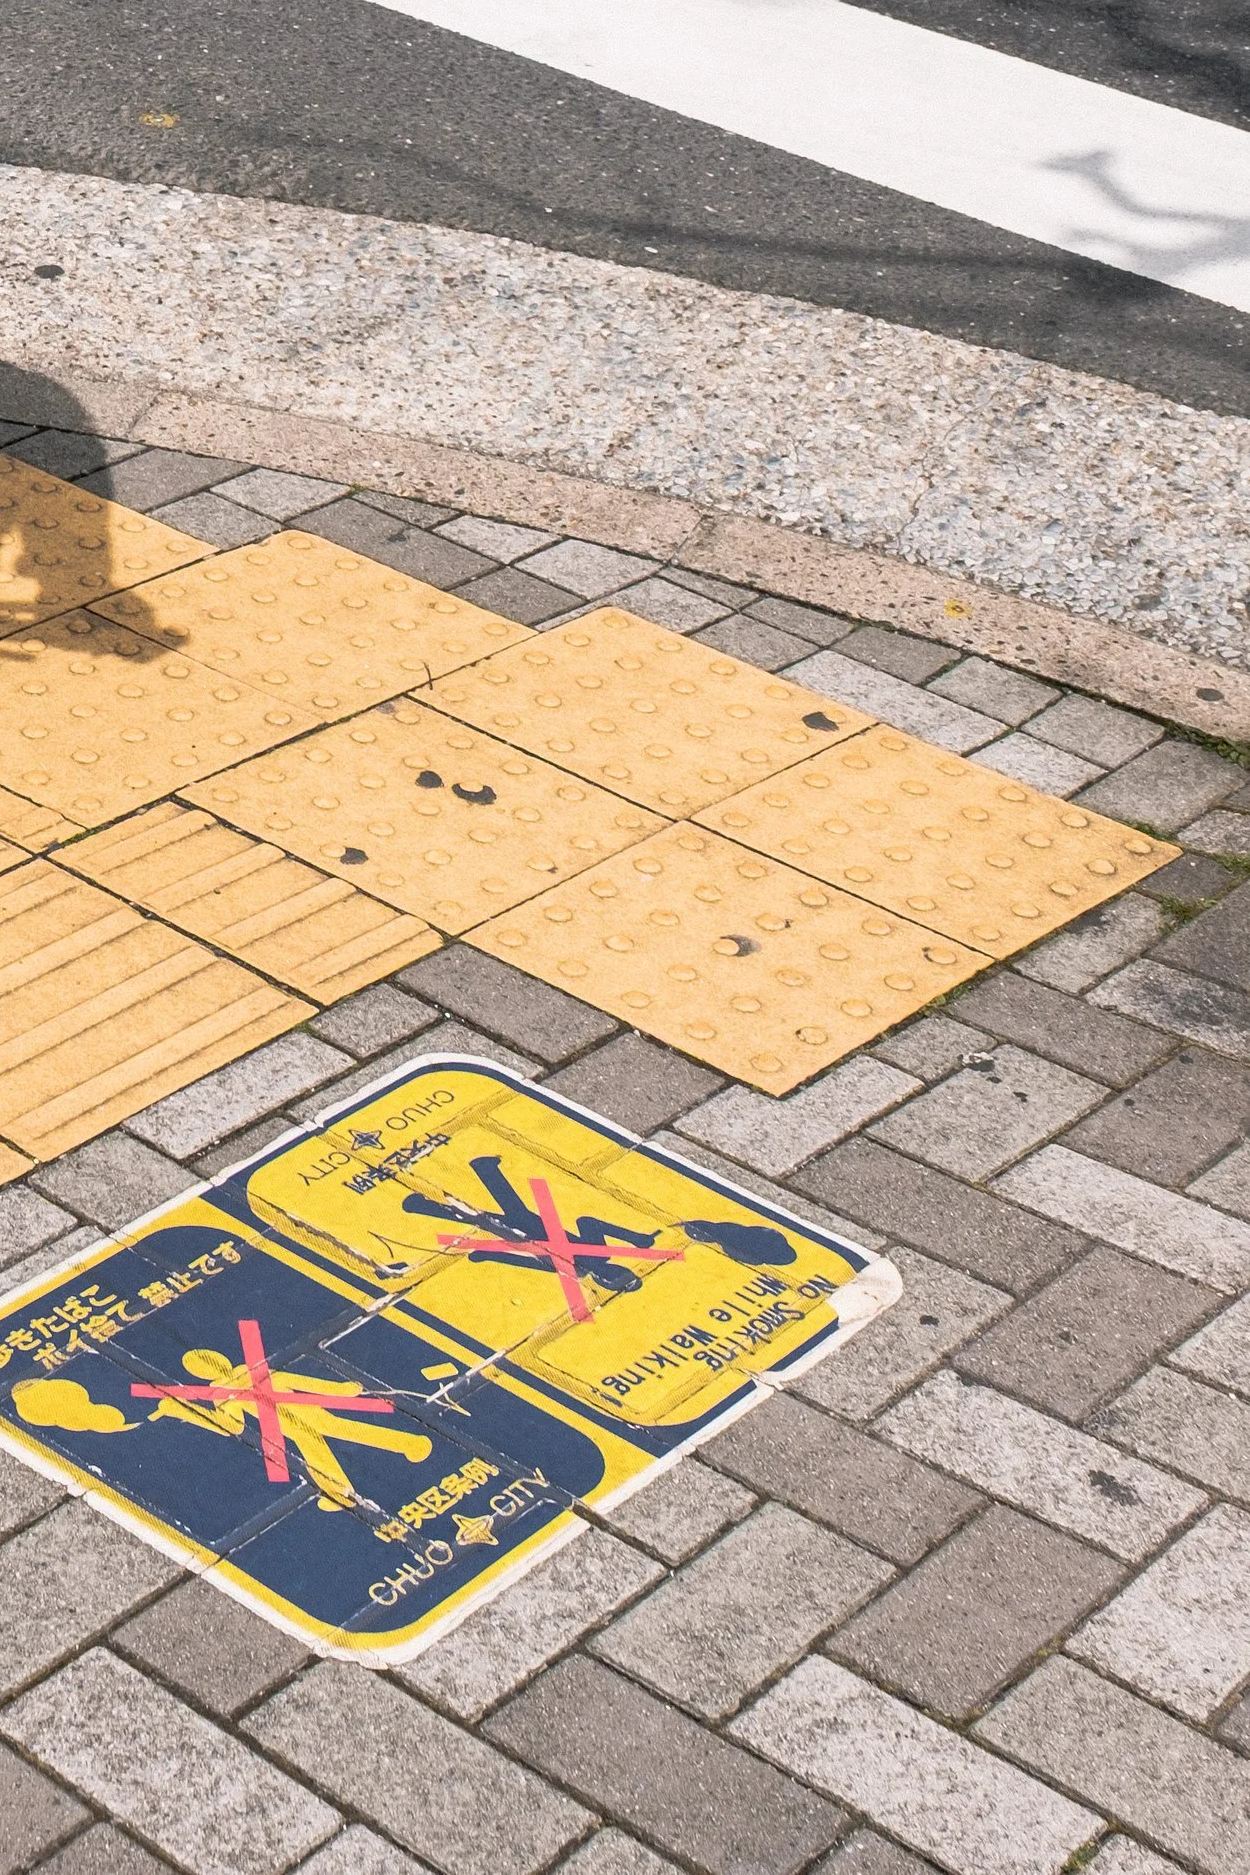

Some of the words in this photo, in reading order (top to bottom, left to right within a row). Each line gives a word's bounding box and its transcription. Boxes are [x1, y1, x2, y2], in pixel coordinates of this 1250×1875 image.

[386, 1090, 454, 1130] CHUO
[297, 1151, 351, 1187] CITY
[138, 1240, 242, 1308] 禁止です
[709, 1273, 791, 1322] While
[33, 1299, 145, 1369] ポイ捨て
[694, 1301, 805, 1371] Smoking
[373, 1457, 500, 1543] 中央区条例
[368, 1539, 453, 1606] CHUO
[489, 1467, 549, 1516] CITY
